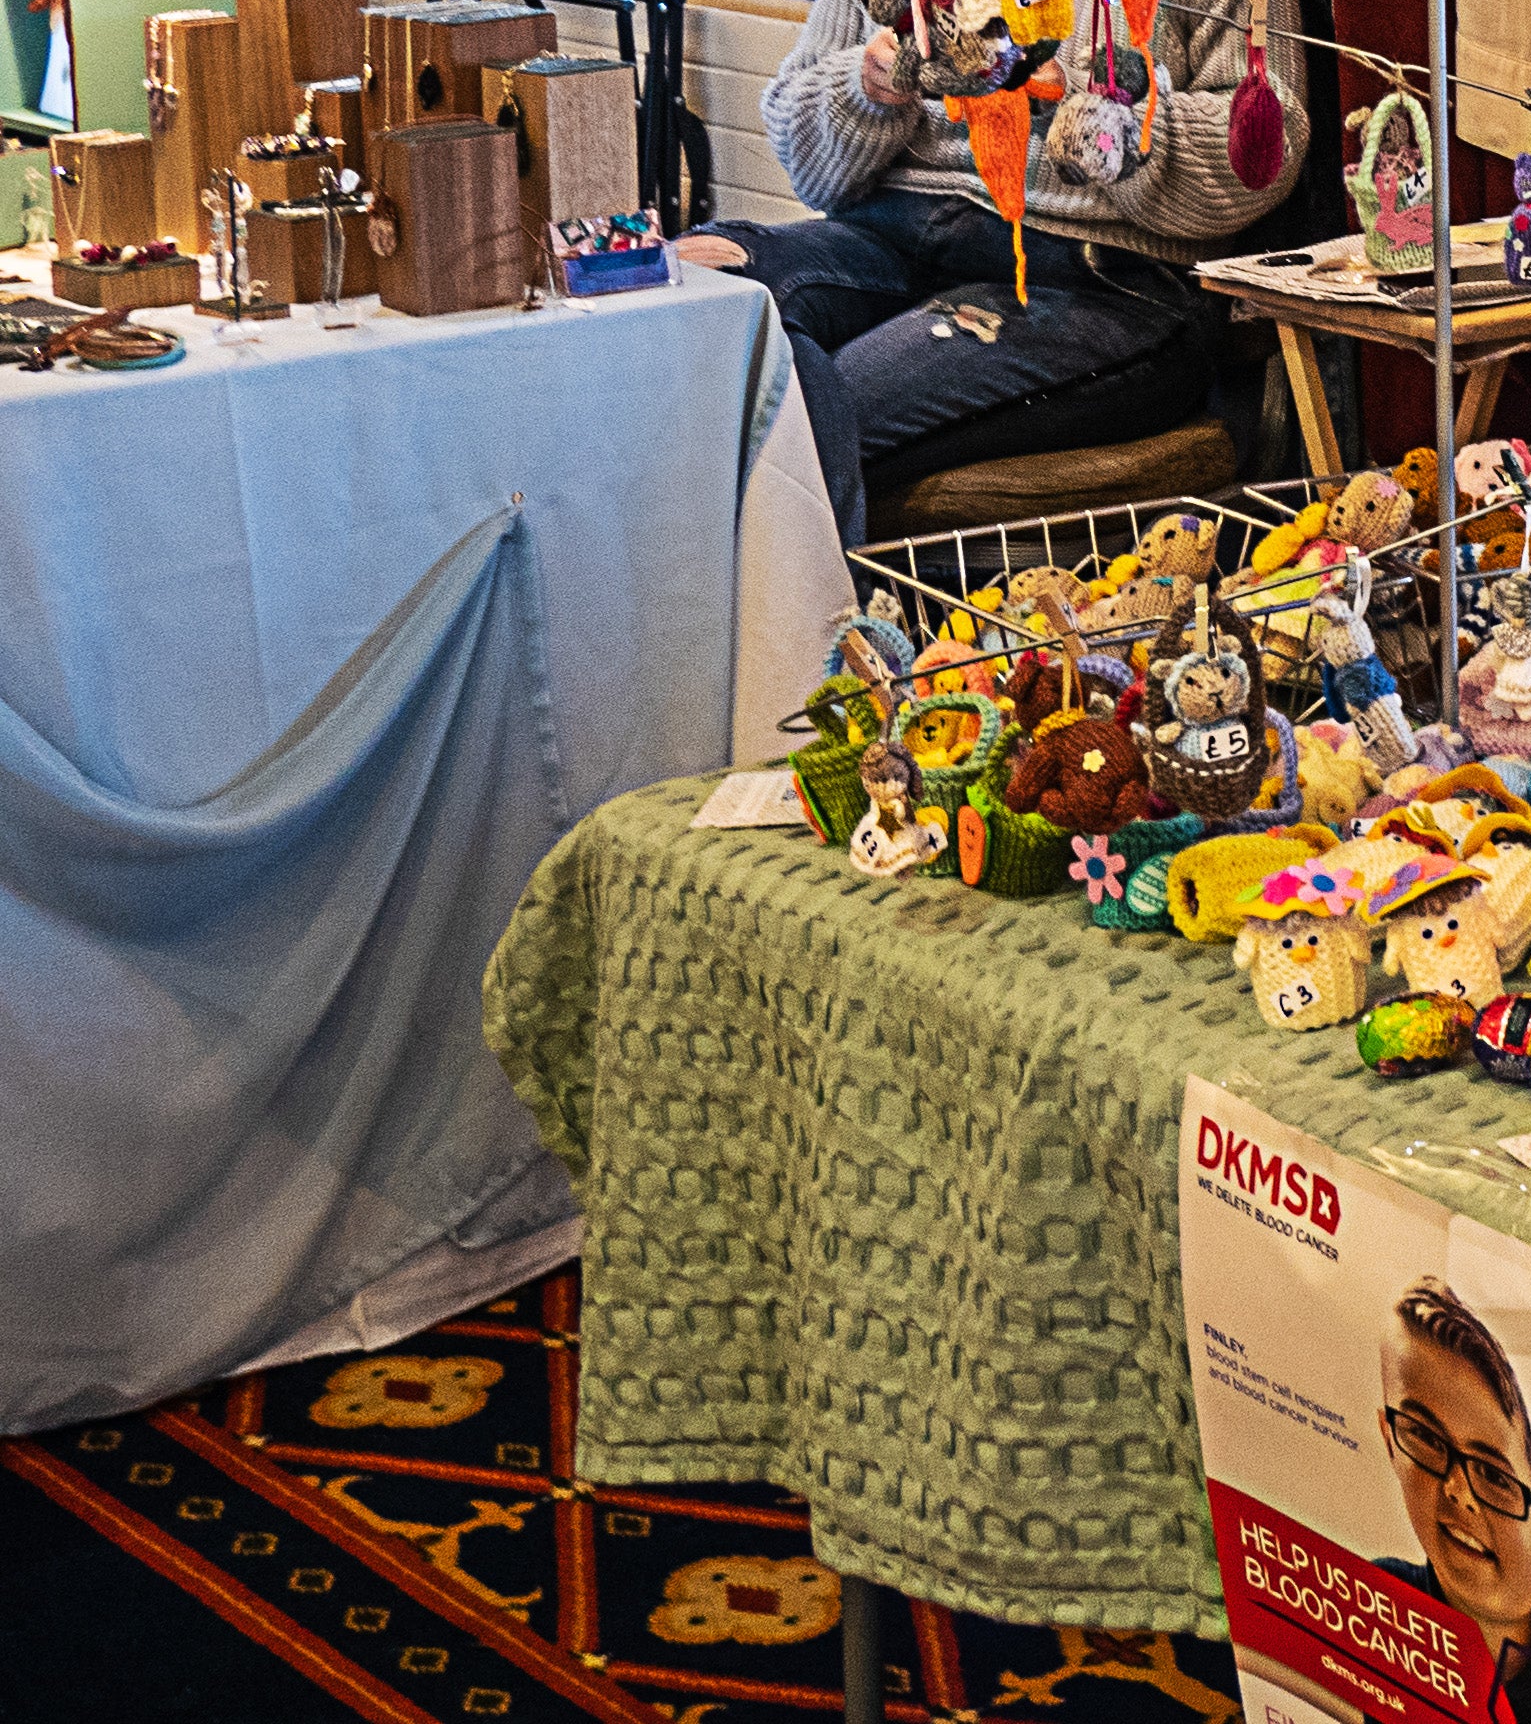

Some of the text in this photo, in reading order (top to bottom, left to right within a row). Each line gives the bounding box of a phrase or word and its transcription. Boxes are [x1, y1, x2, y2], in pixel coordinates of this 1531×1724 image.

[1205, 730, 1247, 757] £5
[1198, 1114, 1309, 1217] DKMS
[1197, 1175, 1340, 1264] WE DELETE BLOOD CANCER
[1233, 1378, 1267, 1406] blood
[1269, 1398, 1308, 1426] cancer
[1240, 1518, 1461, 1664] HELP US DELETE
[1245, 1556, 1470, 1707] BLOOD CANCER
[1321, 1654, 1408, 1714] dkms.org.uk
